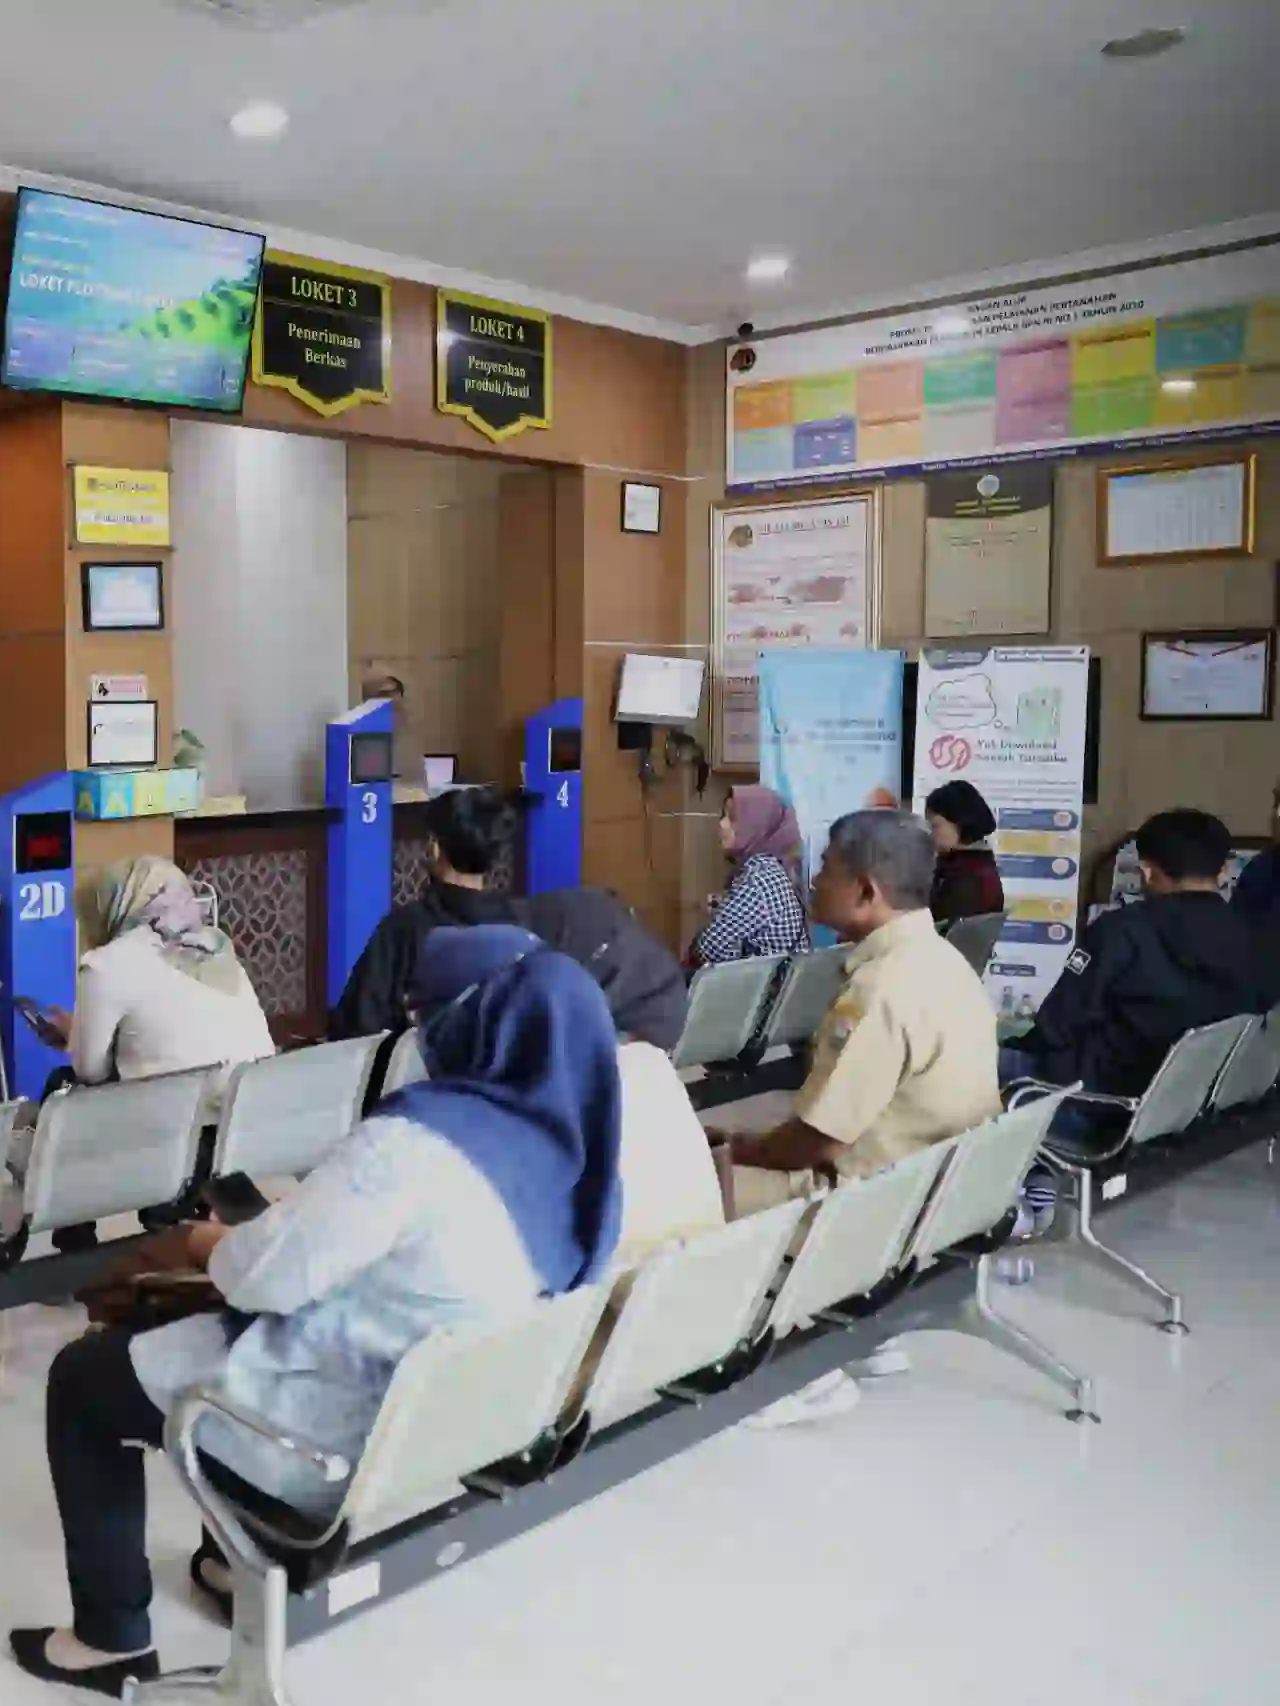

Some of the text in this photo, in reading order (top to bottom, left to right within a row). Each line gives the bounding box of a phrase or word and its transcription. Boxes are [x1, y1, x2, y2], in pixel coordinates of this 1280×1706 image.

[292, 276, 357, 307] LOKET 3
[288, 322, 361, 349] Penerimaan
[470, 315, 524, 342] LOKET 4
[305, 348, 348, 368] Berkas
[468, 355, 526, 379] Penyerahan
[362, 791, 378, 823] 3
[556, 779, 569, 808] 4
[20, 881, 65, 921] 2D
